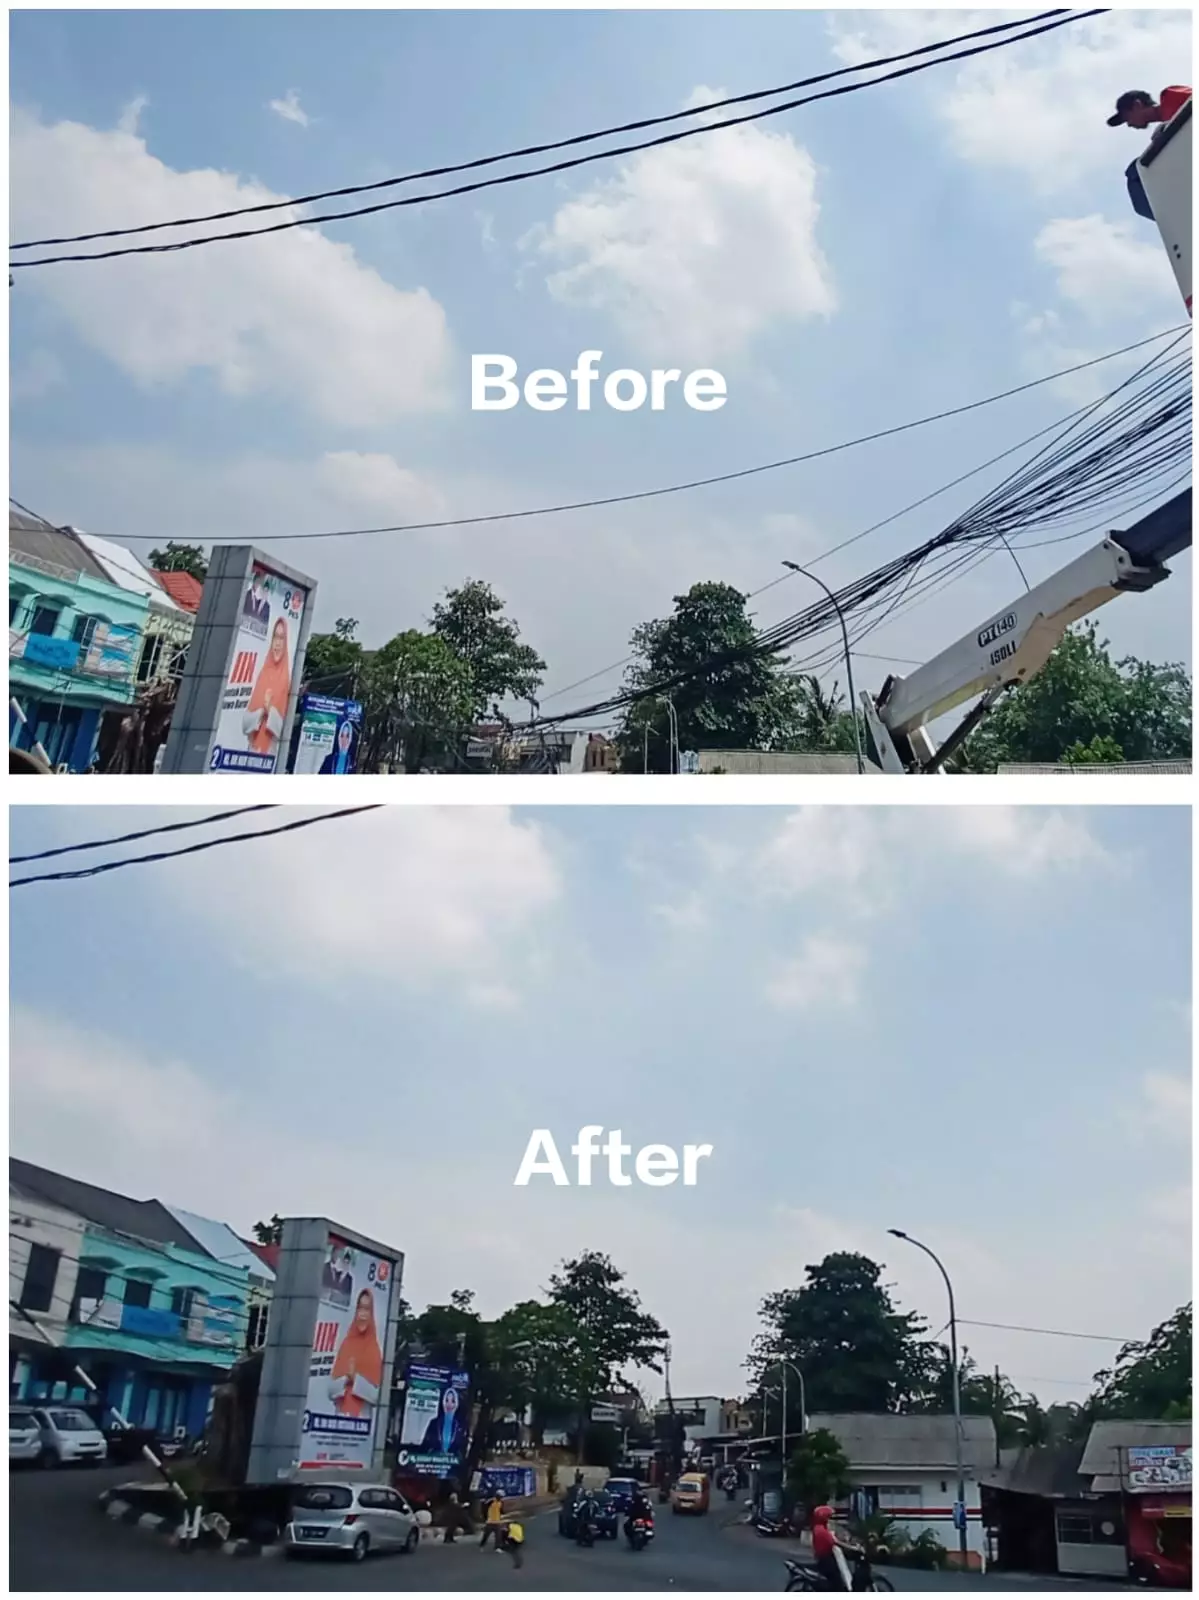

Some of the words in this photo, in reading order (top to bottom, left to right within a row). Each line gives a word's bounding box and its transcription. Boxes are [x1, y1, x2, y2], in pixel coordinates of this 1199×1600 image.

[283, 591, 292, 610] 8
[990, 640, 1017, 666] ISOLI
[210, 748, 220, 768] 2
[367, 1262, 377, 1282] 8
